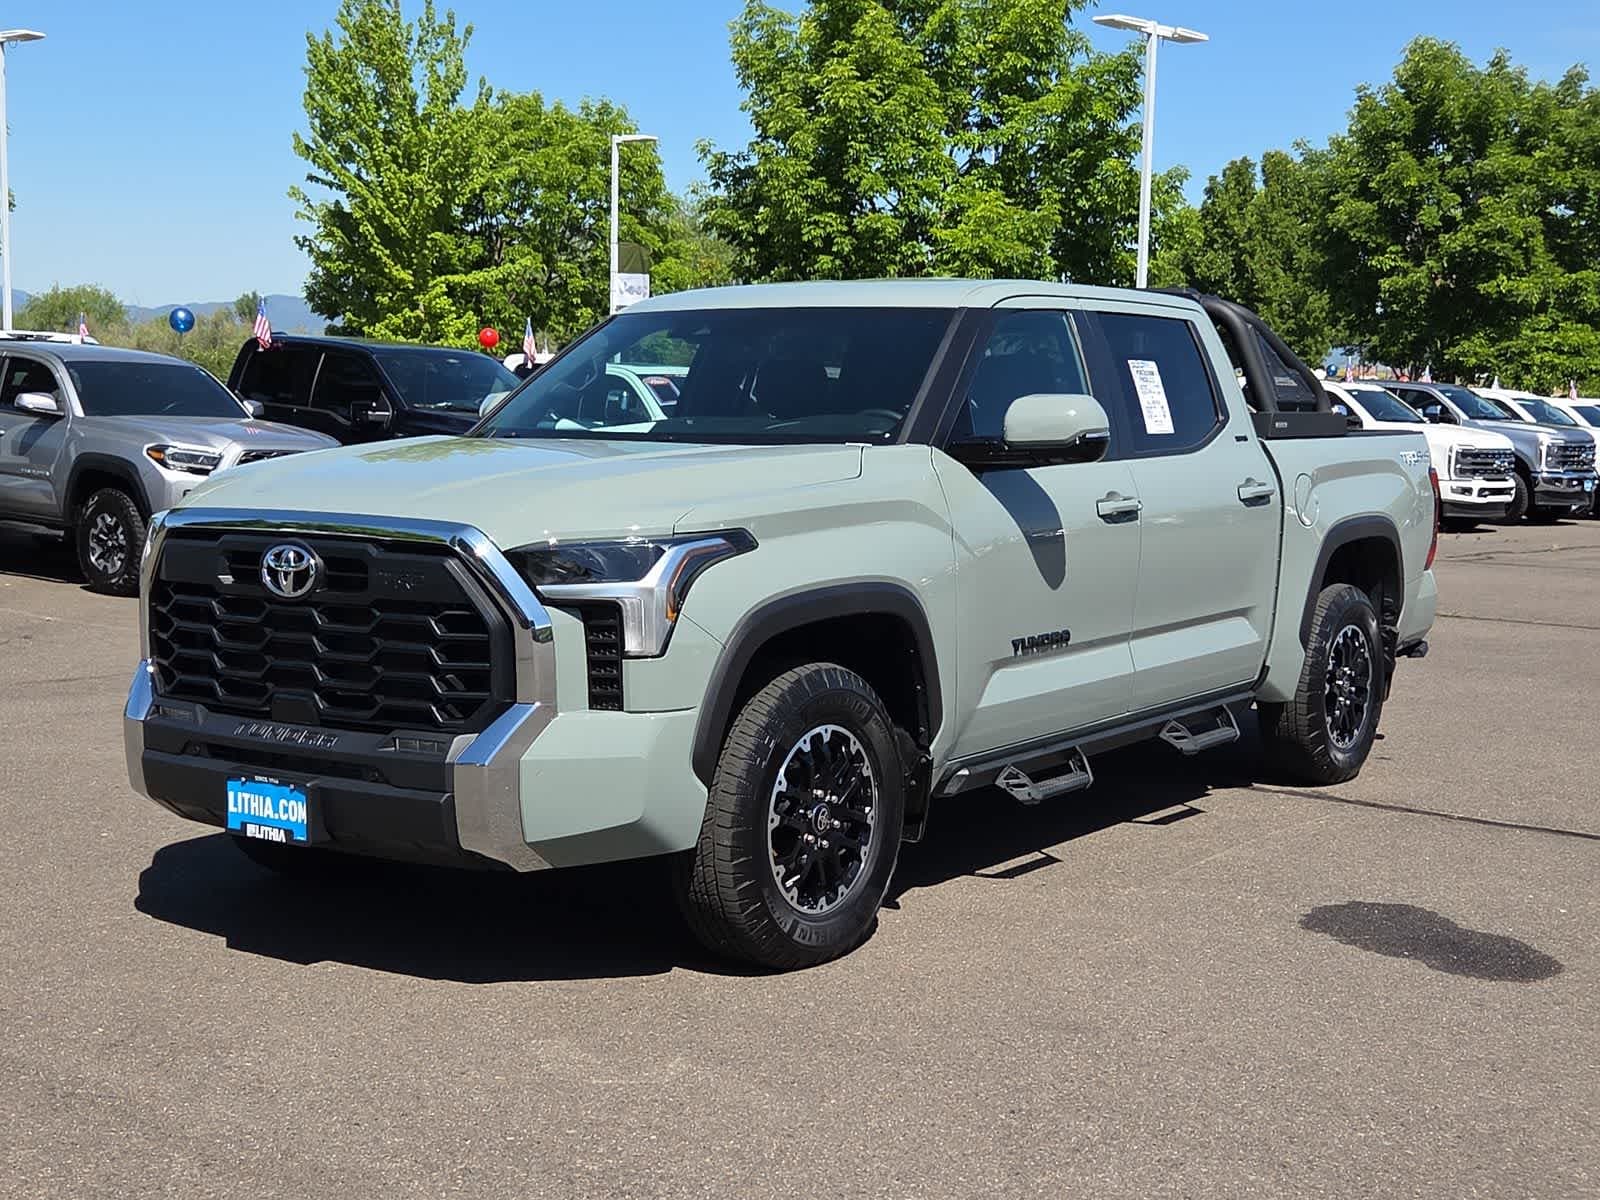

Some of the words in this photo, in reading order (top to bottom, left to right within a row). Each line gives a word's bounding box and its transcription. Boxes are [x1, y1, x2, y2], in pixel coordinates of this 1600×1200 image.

[1011, 629, 1071, 657] TUNDRA
[227, 790, 307, 825] LITHIA.COM
[255, 824, 287, 843] LITHIA
